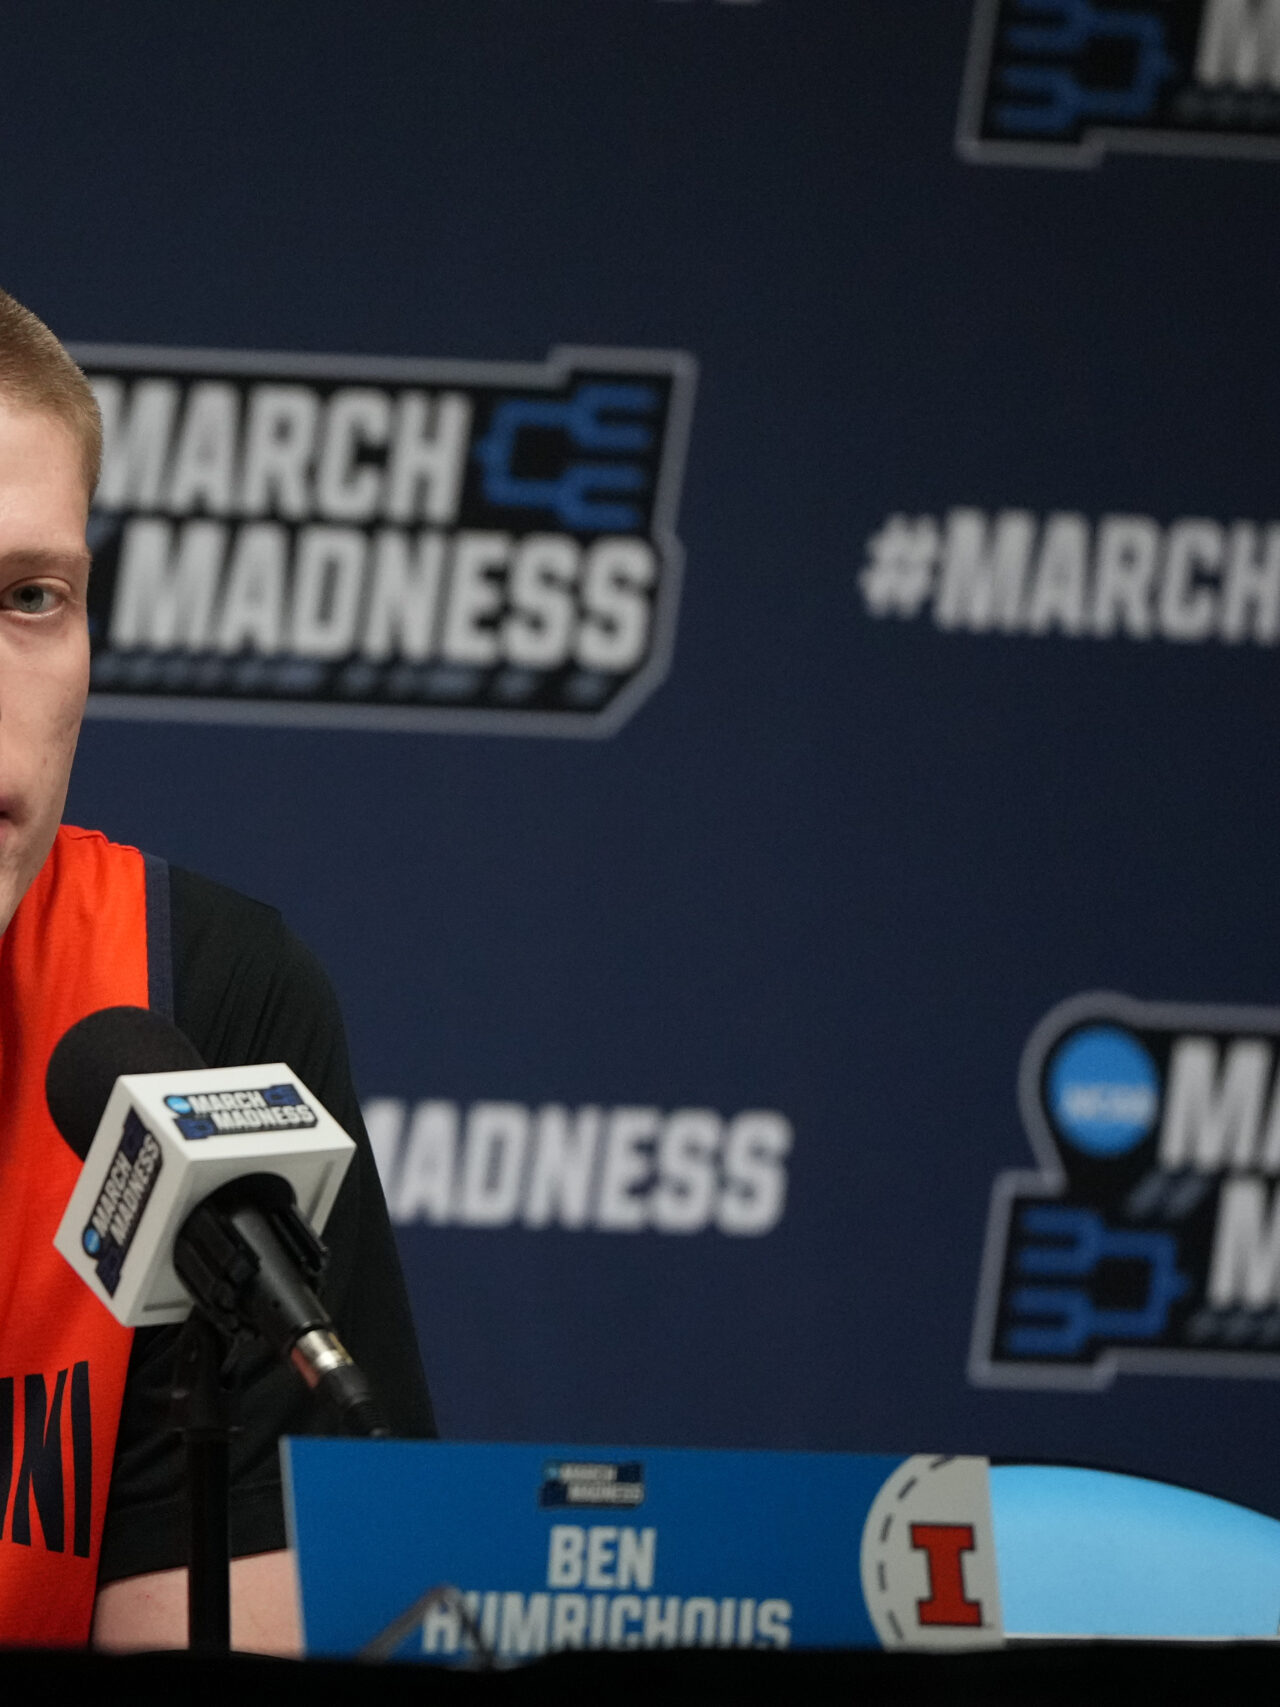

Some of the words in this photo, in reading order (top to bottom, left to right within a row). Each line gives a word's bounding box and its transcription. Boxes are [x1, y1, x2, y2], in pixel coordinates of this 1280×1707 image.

[109, 518, 659, 672] MADNESS
[188, 1091, 268, 1115] MARCH
[210, 1104, 315, 1131] MADNESS
[92, 1151, 133, 1238] MARCH
[110, 1132, 160, 1246] MADNESS
[547, 1524, 657, 1590] BEN
